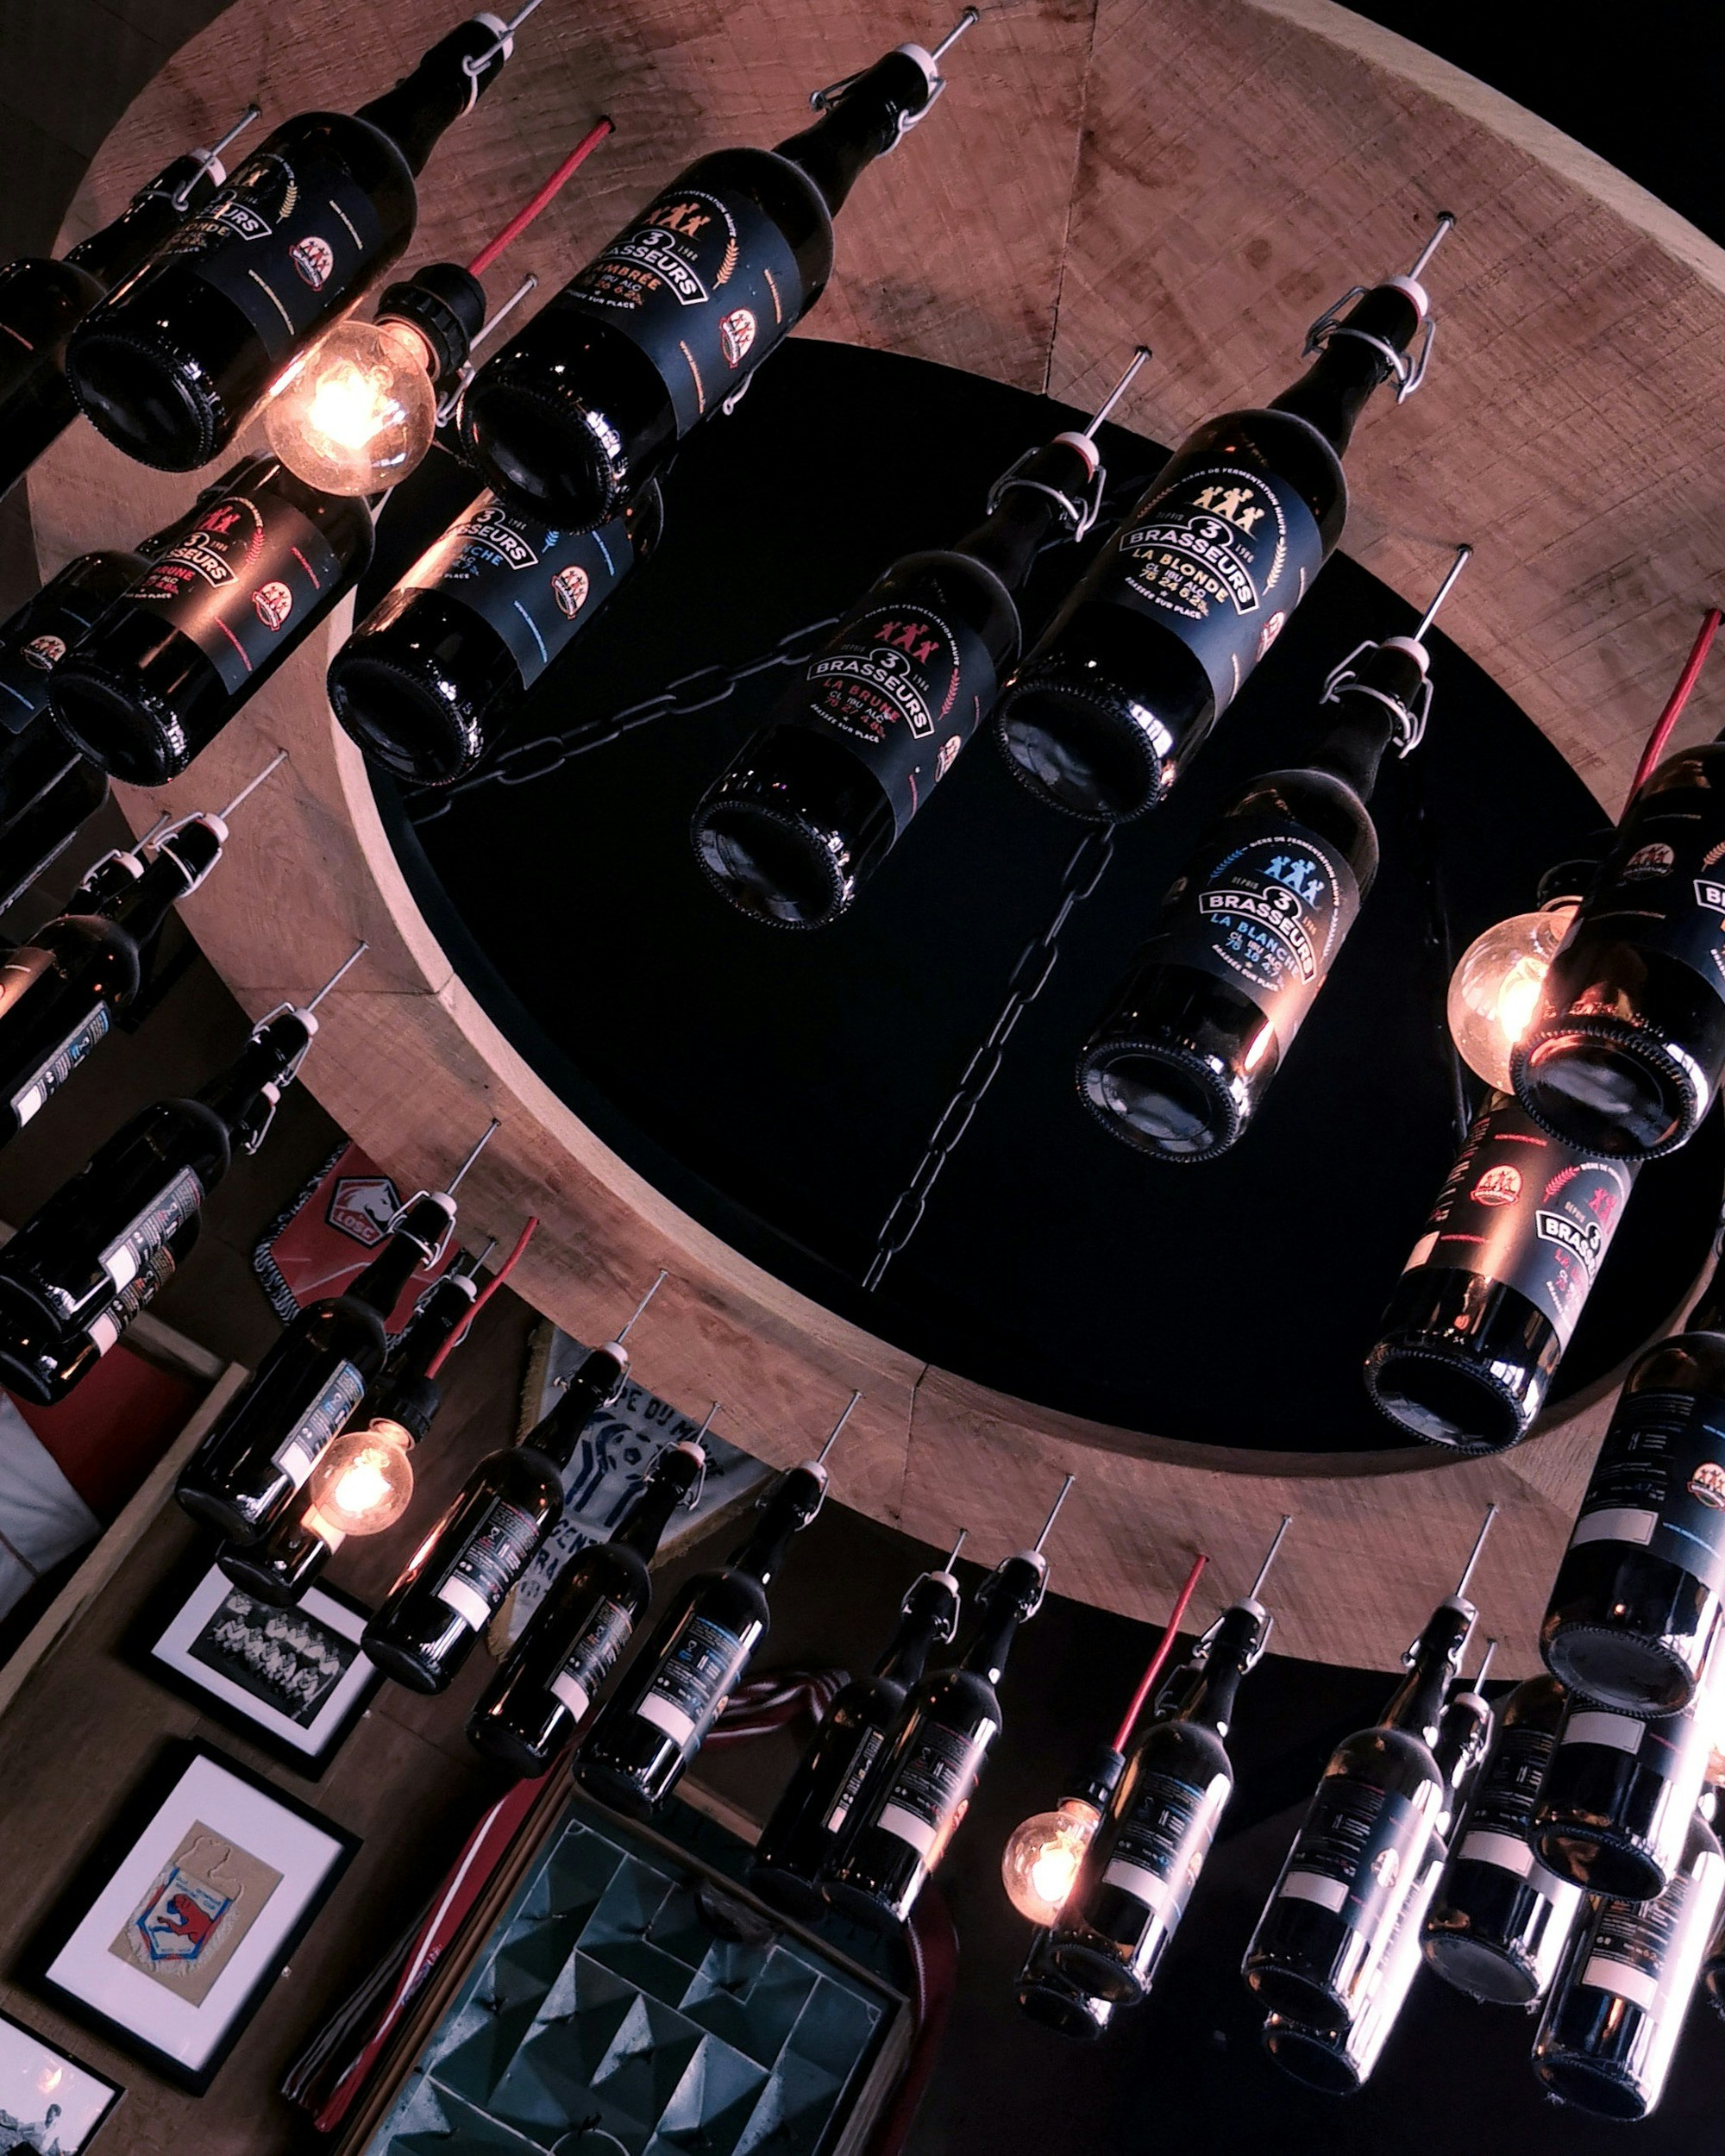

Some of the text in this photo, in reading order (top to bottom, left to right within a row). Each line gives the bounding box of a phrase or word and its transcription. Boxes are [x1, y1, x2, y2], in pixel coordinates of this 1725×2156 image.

[643, 232, 664, 246] 3
[606, 299, 636, 310] PLACE
[1222, 467, 1280, 506] FERMENTATION
[1275, 506, 1287, 536] HAUTE
[477, 509, 495, 523] 3
[1200, 520, 1222, 539] 3
[184, 533, 199, 547] 3
[1129, 530, 1252, 604] BRASSEURS
[1132, 548, 1229, 604] LA BLONDE
[1157, 576, 1179, 592] 24
[1164, 569, 1184, 583] IBU
[1183, 580, 1207, 599] ALC
[1155, 597, 1174, 609] SUR
[1174, 605, 1202, 619] PLACE
[880, 652, 900, 668] 3
[816, 660, 928, 729] BRASSEURS
[823, 677, 901, 724] LA BRUNE
[830, 690, 884, 724] CL IBU ALC
[837, 722, 854, 733] SUR
[855, 730, 880, 743] PLACE
[1274, 891, 1292, 911] 3
[1209, 895, 1314, 975] BRASSEURS
[1210, 913, 1301, 979] LA BLANCHE
[336, 1211, 376, 1239] LOSC
[644, 1398, 675, 1426] DU
